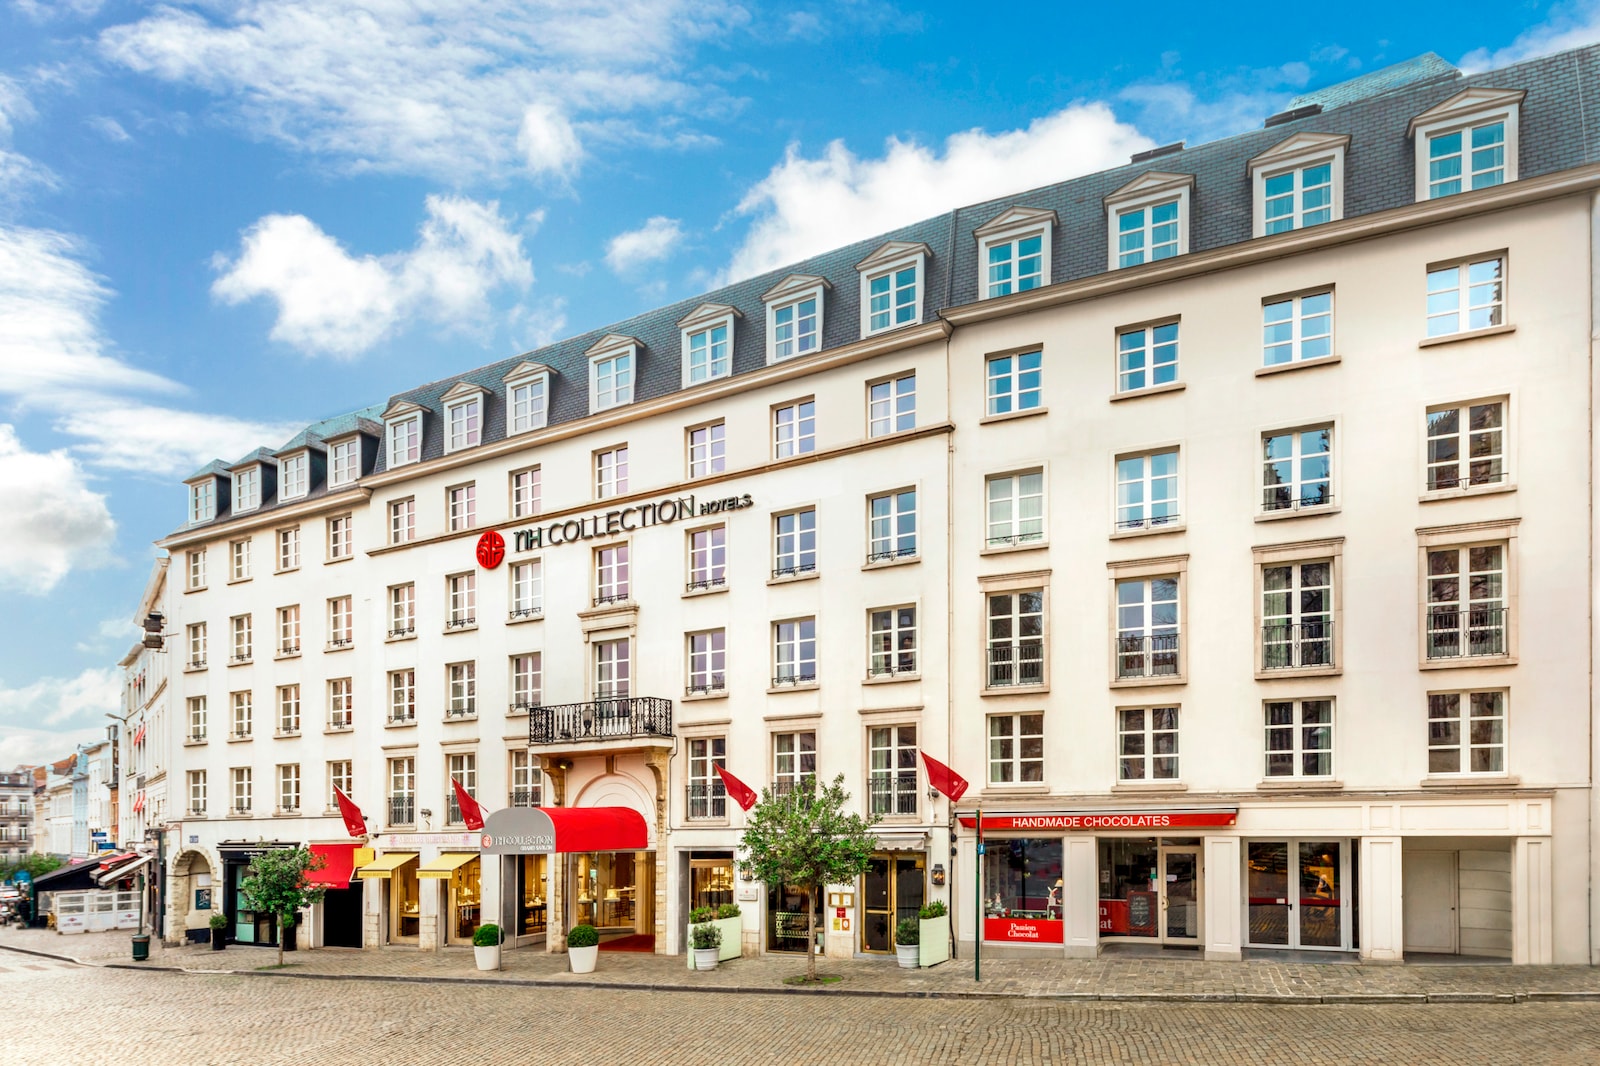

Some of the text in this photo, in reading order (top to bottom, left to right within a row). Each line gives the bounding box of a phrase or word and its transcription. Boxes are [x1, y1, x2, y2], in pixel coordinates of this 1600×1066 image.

[548, 495, 695, 545] COLLECTION
[700, 493, 754, 515] HOTELS
[1012, 815, 1170, 828] HANDMADE CHOCOLATES
[1007, 930, 1039, 939] Chocolat
